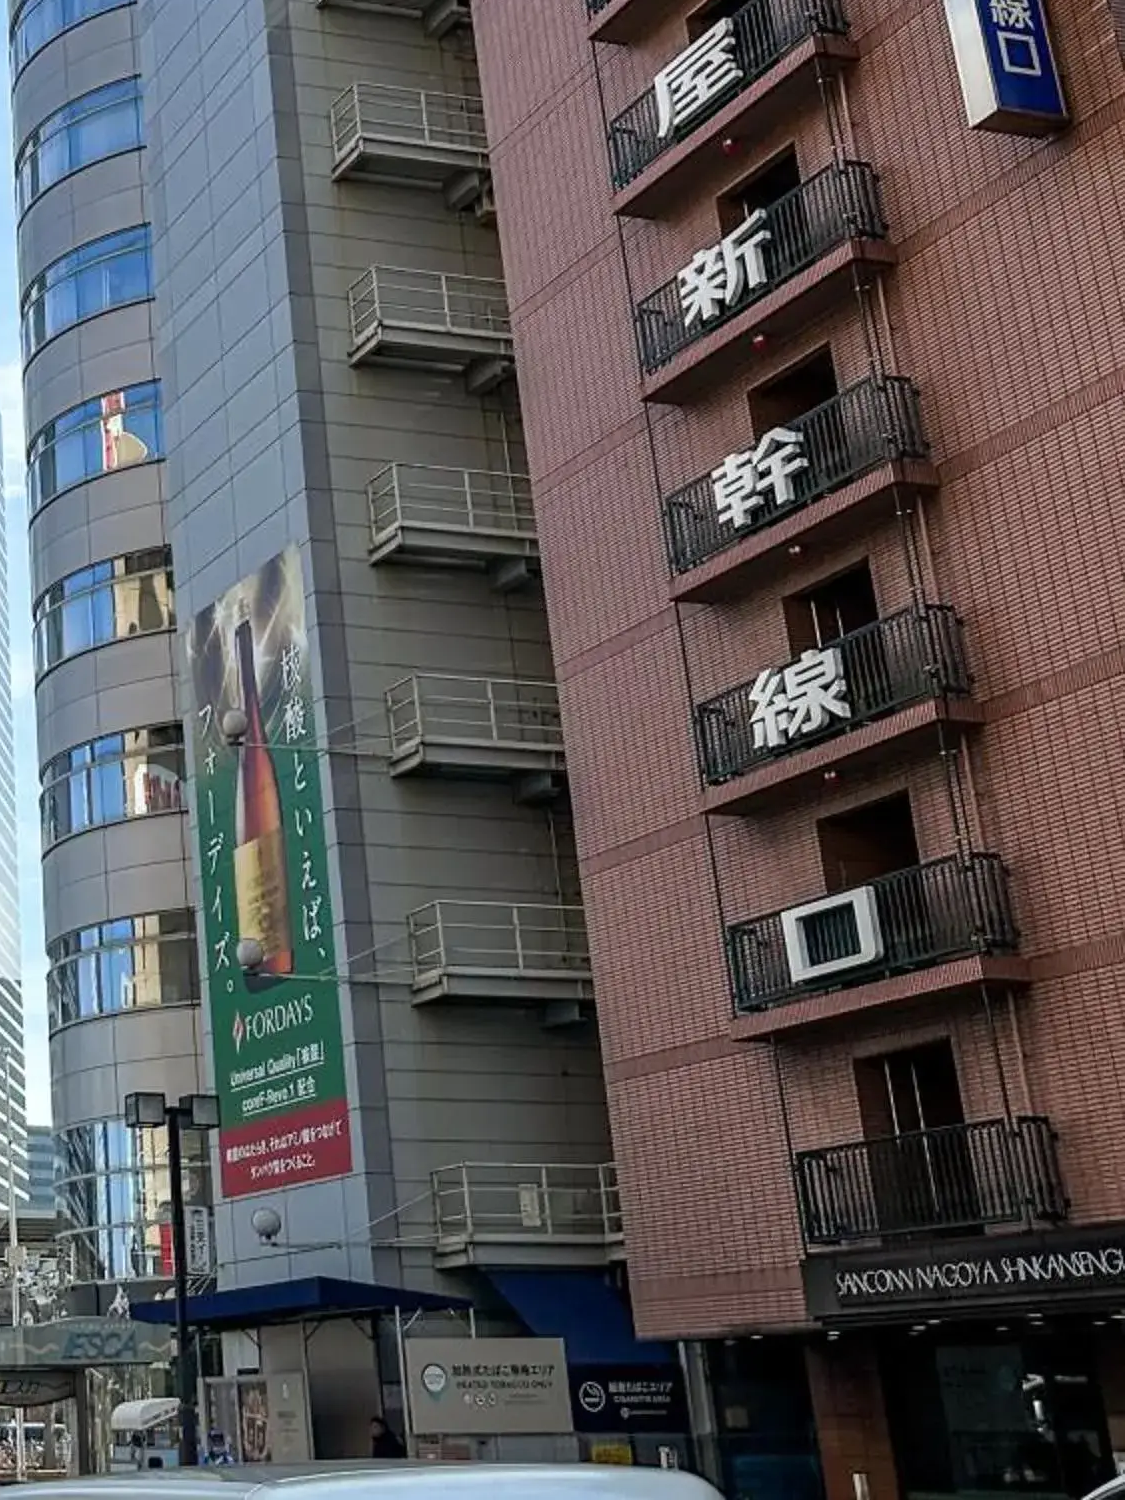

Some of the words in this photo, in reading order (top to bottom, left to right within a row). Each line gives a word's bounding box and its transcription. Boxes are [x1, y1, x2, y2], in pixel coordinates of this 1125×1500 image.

[245, 994, 314, 1043] FORDAYS
[230, 1061, 266, 1087] Universal
[916, 1261, 999, 1290] NAGOYA
